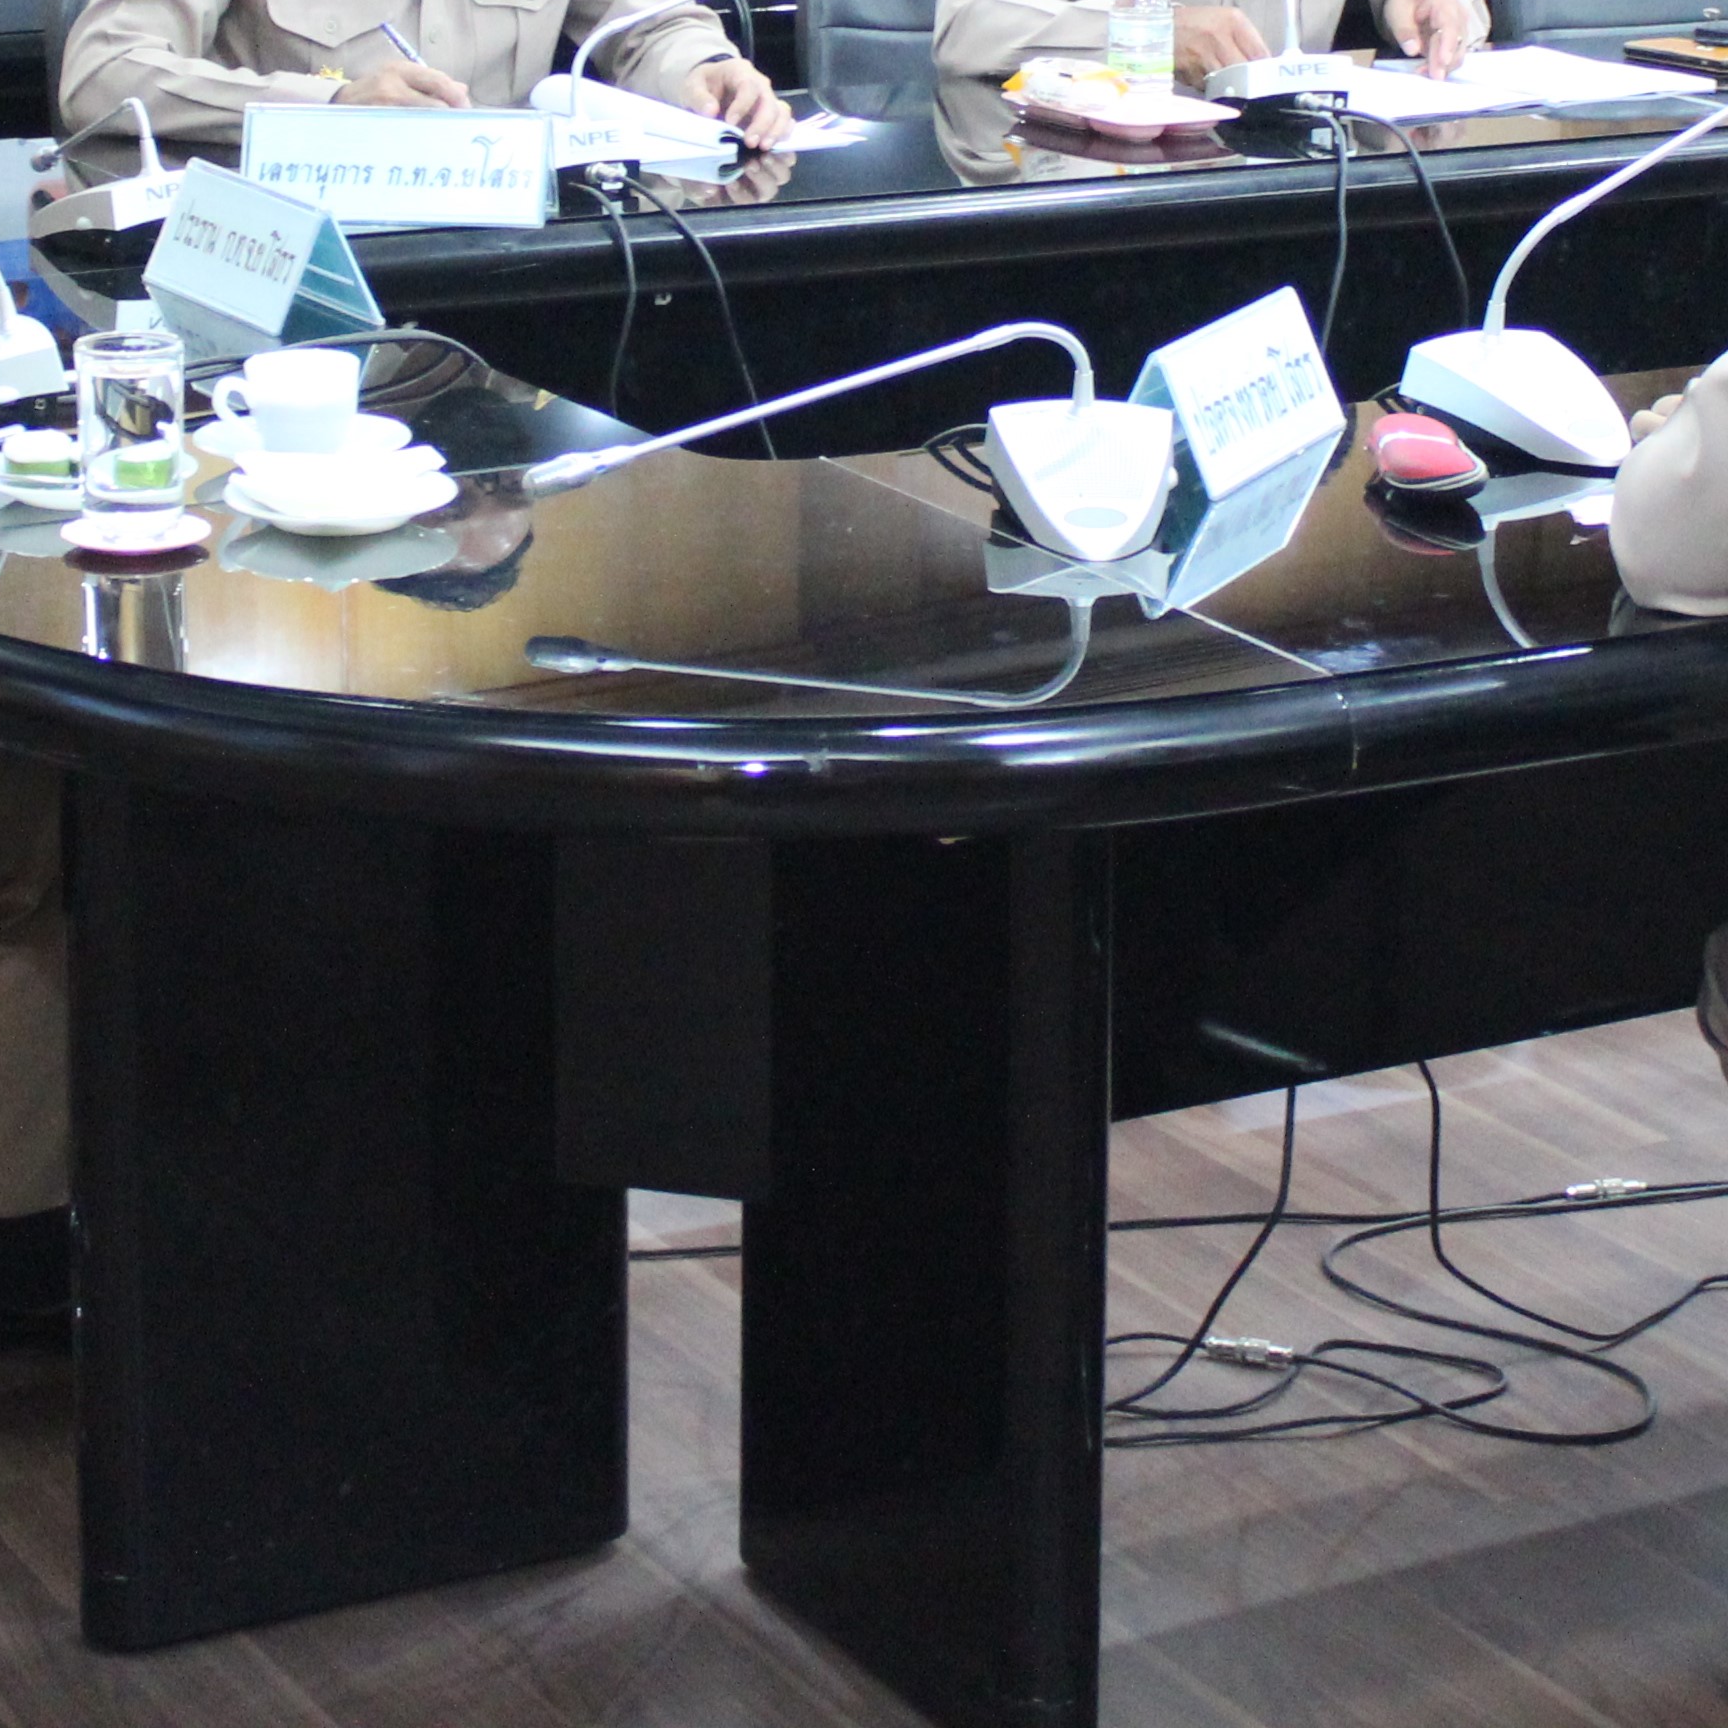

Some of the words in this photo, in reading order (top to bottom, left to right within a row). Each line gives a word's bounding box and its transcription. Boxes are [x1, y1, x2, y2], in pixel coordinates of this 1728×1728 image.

[1278, 62, 1329, 77] NPE
[569, 128, 622, 148] NPE
[258, 161, 375, 200] เลขานุการ
